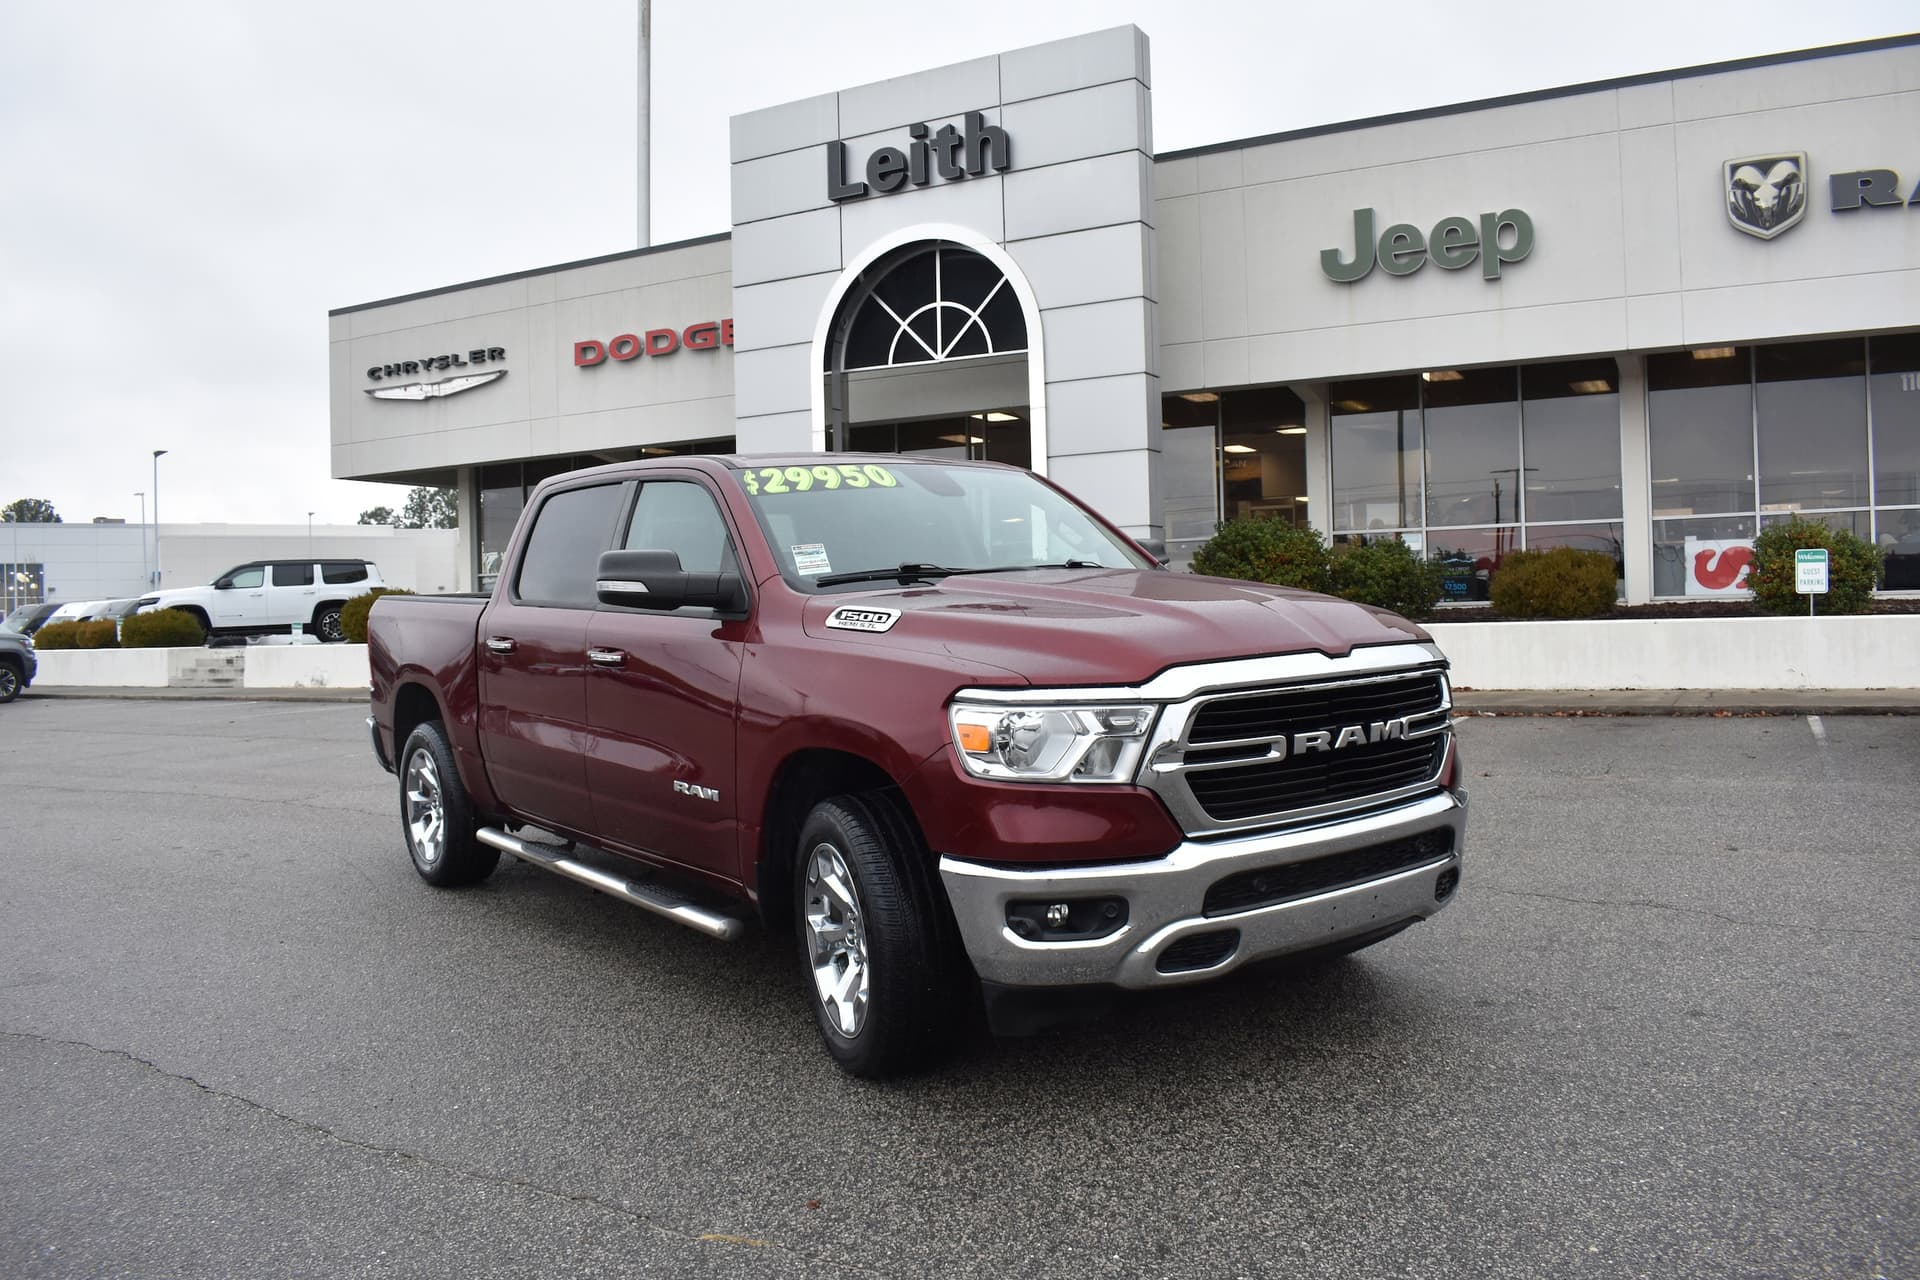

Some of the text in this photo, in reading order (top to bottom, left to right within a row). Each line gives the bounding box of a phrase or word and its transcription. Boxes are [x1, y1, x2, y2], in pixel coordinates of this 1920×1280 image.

[826, 111, 1011, 202] Leith
[1829, 169, 1920, 213] R
[1320, 207, 1535, 282] Jeep
[366, 346, 507, 381] CHRYSLER
[743, 464, 897, 496] $29950
[1802, 568, 1820, 576] GUEST
[840, 611, 889, 623] 1500
[1293, 719, 1401, 756] RAM
[673, 780, 720, 803] RAM
